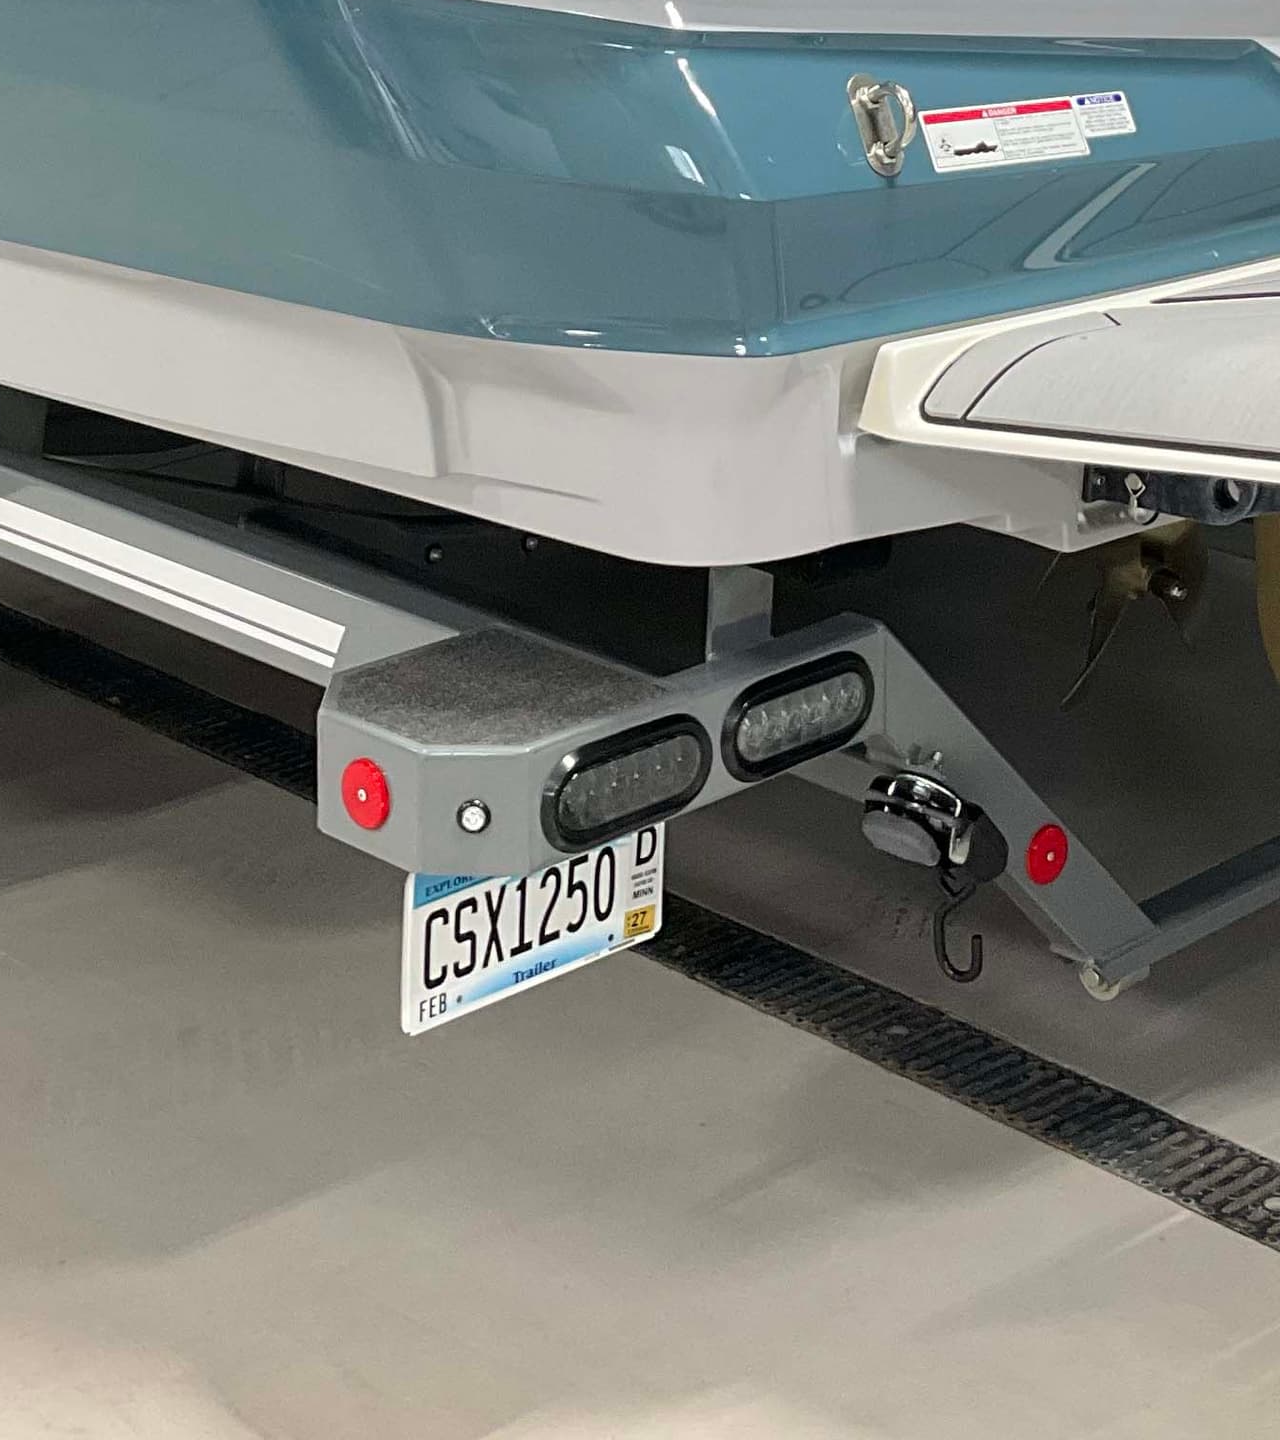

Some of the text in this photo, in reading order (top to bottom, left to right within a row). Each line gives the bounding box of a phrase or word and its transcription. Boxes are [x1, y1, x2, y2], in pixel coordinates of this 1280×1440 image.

[423, 845, 616, 990] CSX1250
[631, 911, 647, 928] 27
[512, 959, 557, 984] Trailer
[419, 992, 447, 1022] FEB
